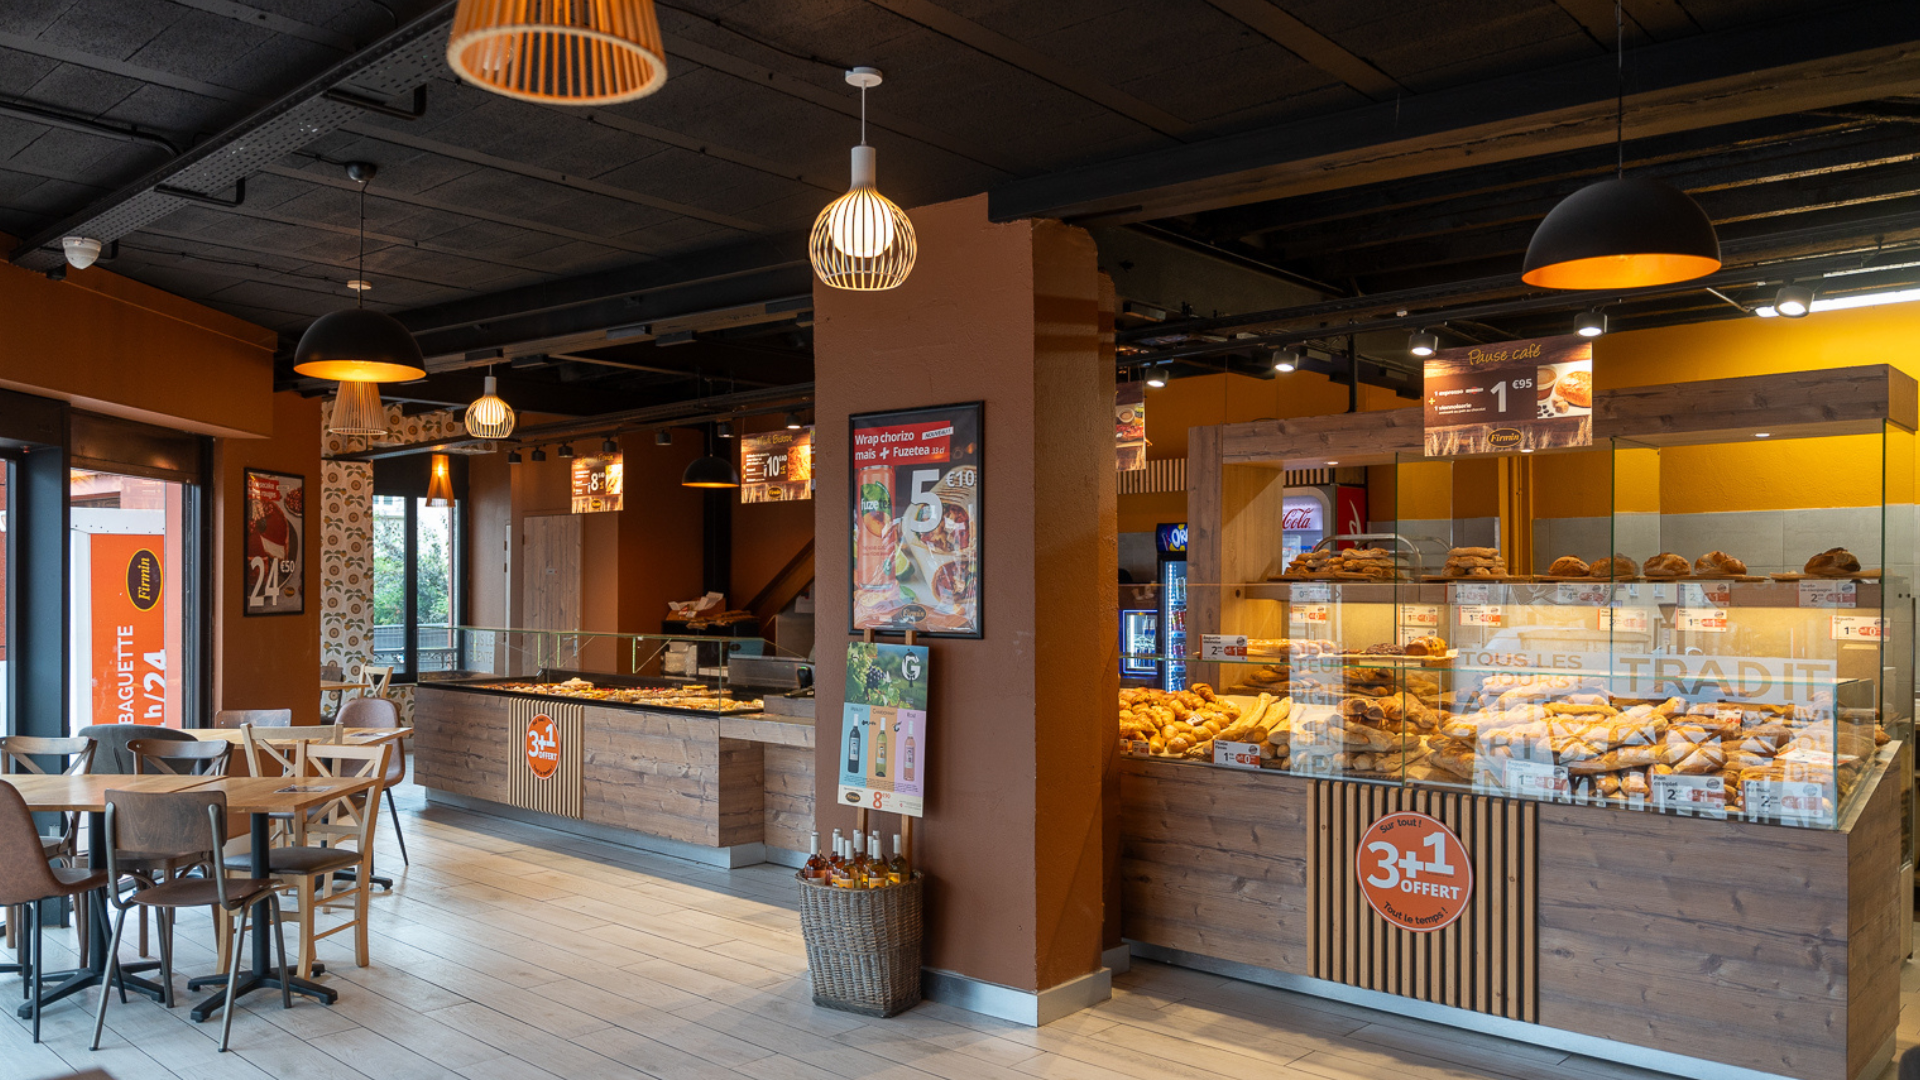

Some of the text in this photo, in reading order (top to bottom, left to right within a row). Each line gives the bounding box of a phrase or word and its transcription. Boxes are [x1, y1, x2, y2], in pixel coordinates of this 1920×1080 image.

[1467, 343, 1541, 366] Pause café
[1490, 378, 1533, 413] 1 €95
[855, 434, 879, 446] Wrap
[880, 430, 914, 443] chorizo
[1490, 433, 1520, 442] Firmin
[855, 448, 876, 460] maïs
[893, 446, 930, 457] Fuzetea
[766, 455, 779, 477] 10
[591, 472, 599, 491] 8
[911, 469, 975, 533] 5 €10
[1282, 507, 1314, 529] Cola
[138, 557, 150, 601] Firmin
[250, 556, 295, 606] 24 €50
[1811, 593, 1818, 602] 2
[1211, 645, 1218, 655] 2
[1461, 651, 1583, 669] TOUS LES
[117, 625, 134, 724] BAGUETTE
[528, 723, 556, 757] 3+1
[538, 751, 558, 761] OFFERT
[1224, 752, 1228, 761] 1
[1518, 774, 1524, 785] 1
[872, 791, 883, 809] 8
[1667, 788, 1676, 801] 2
[1761, 795, 1771, 808] 2
[1379, 822, 1394, 834] Sur
[1397, 818, 1417, 827] tout
[1367, 831, 1455, 889] 3+1
[1400, 879, 1460, 900] OFFERT
[1383, 901, 1403, 920] Tout
[1404, 914, 1413, 924] le
[1415, 910, 1444, 925] temps
